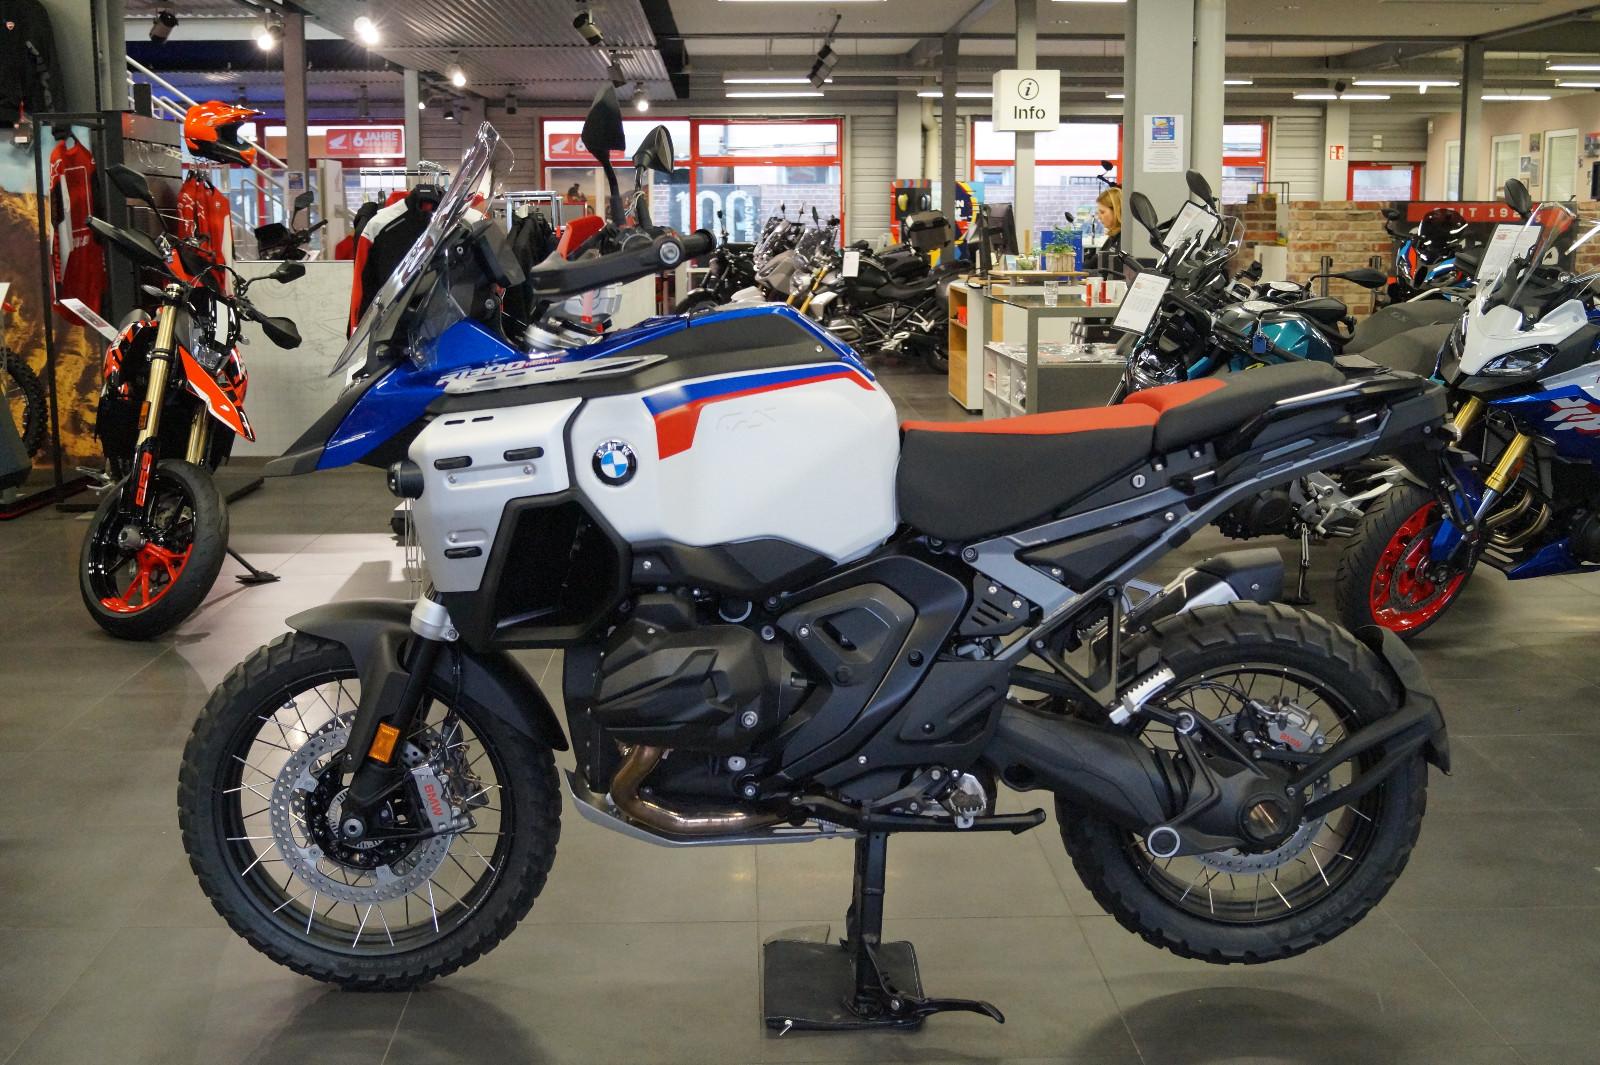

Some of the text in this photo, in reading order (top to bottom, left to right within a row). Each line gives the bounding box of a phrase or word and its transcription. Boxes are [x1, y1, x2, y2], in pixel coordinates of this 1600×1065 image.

[1014, 106, 1046, 119] Info
[352, 132, 364, 147] 6
[365, 131, 399, 141] JAHRE
[597, 440, 632, 458] BMW
[423, 783, 444, 817] BMW
